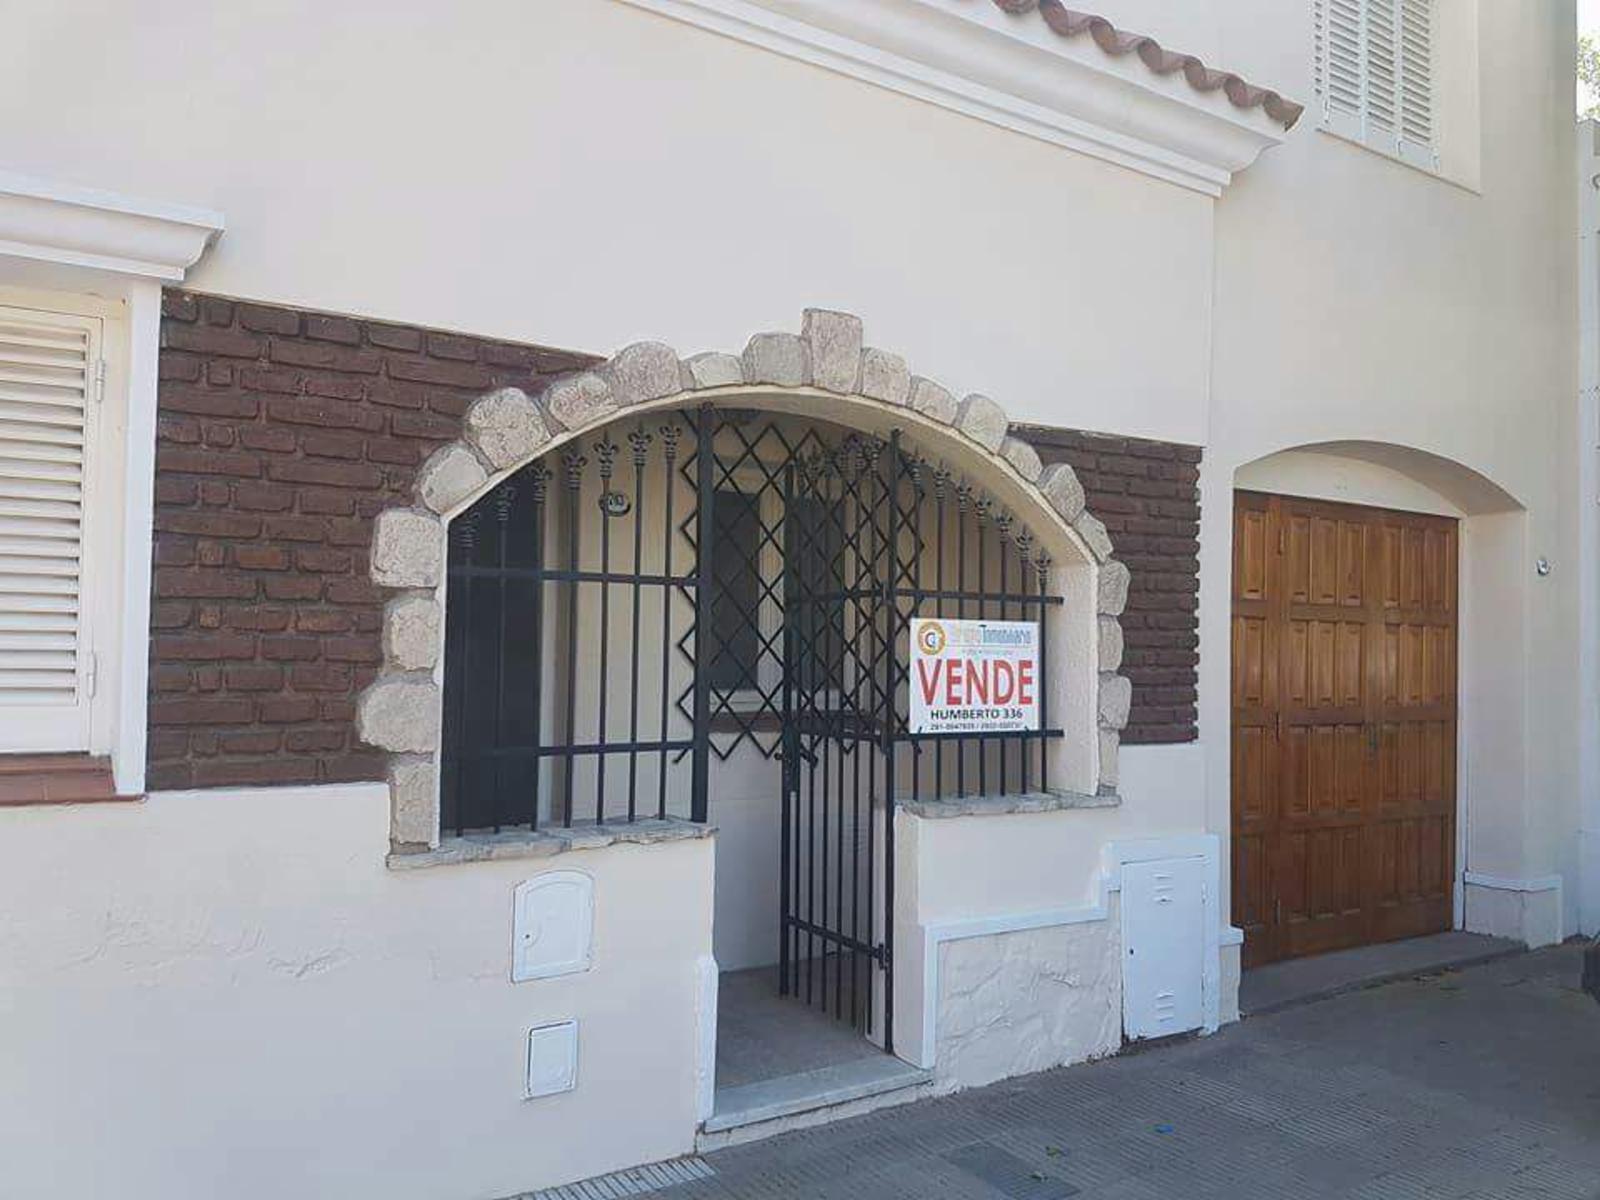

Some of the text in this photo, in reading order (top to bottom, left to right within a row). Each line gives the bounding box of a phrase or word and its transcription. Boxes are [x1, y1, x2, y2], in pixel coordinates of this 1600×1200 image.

[917, 658, 1033, 706] VENDE
[930, 708, 1023, 720] HUMBERTO 336
